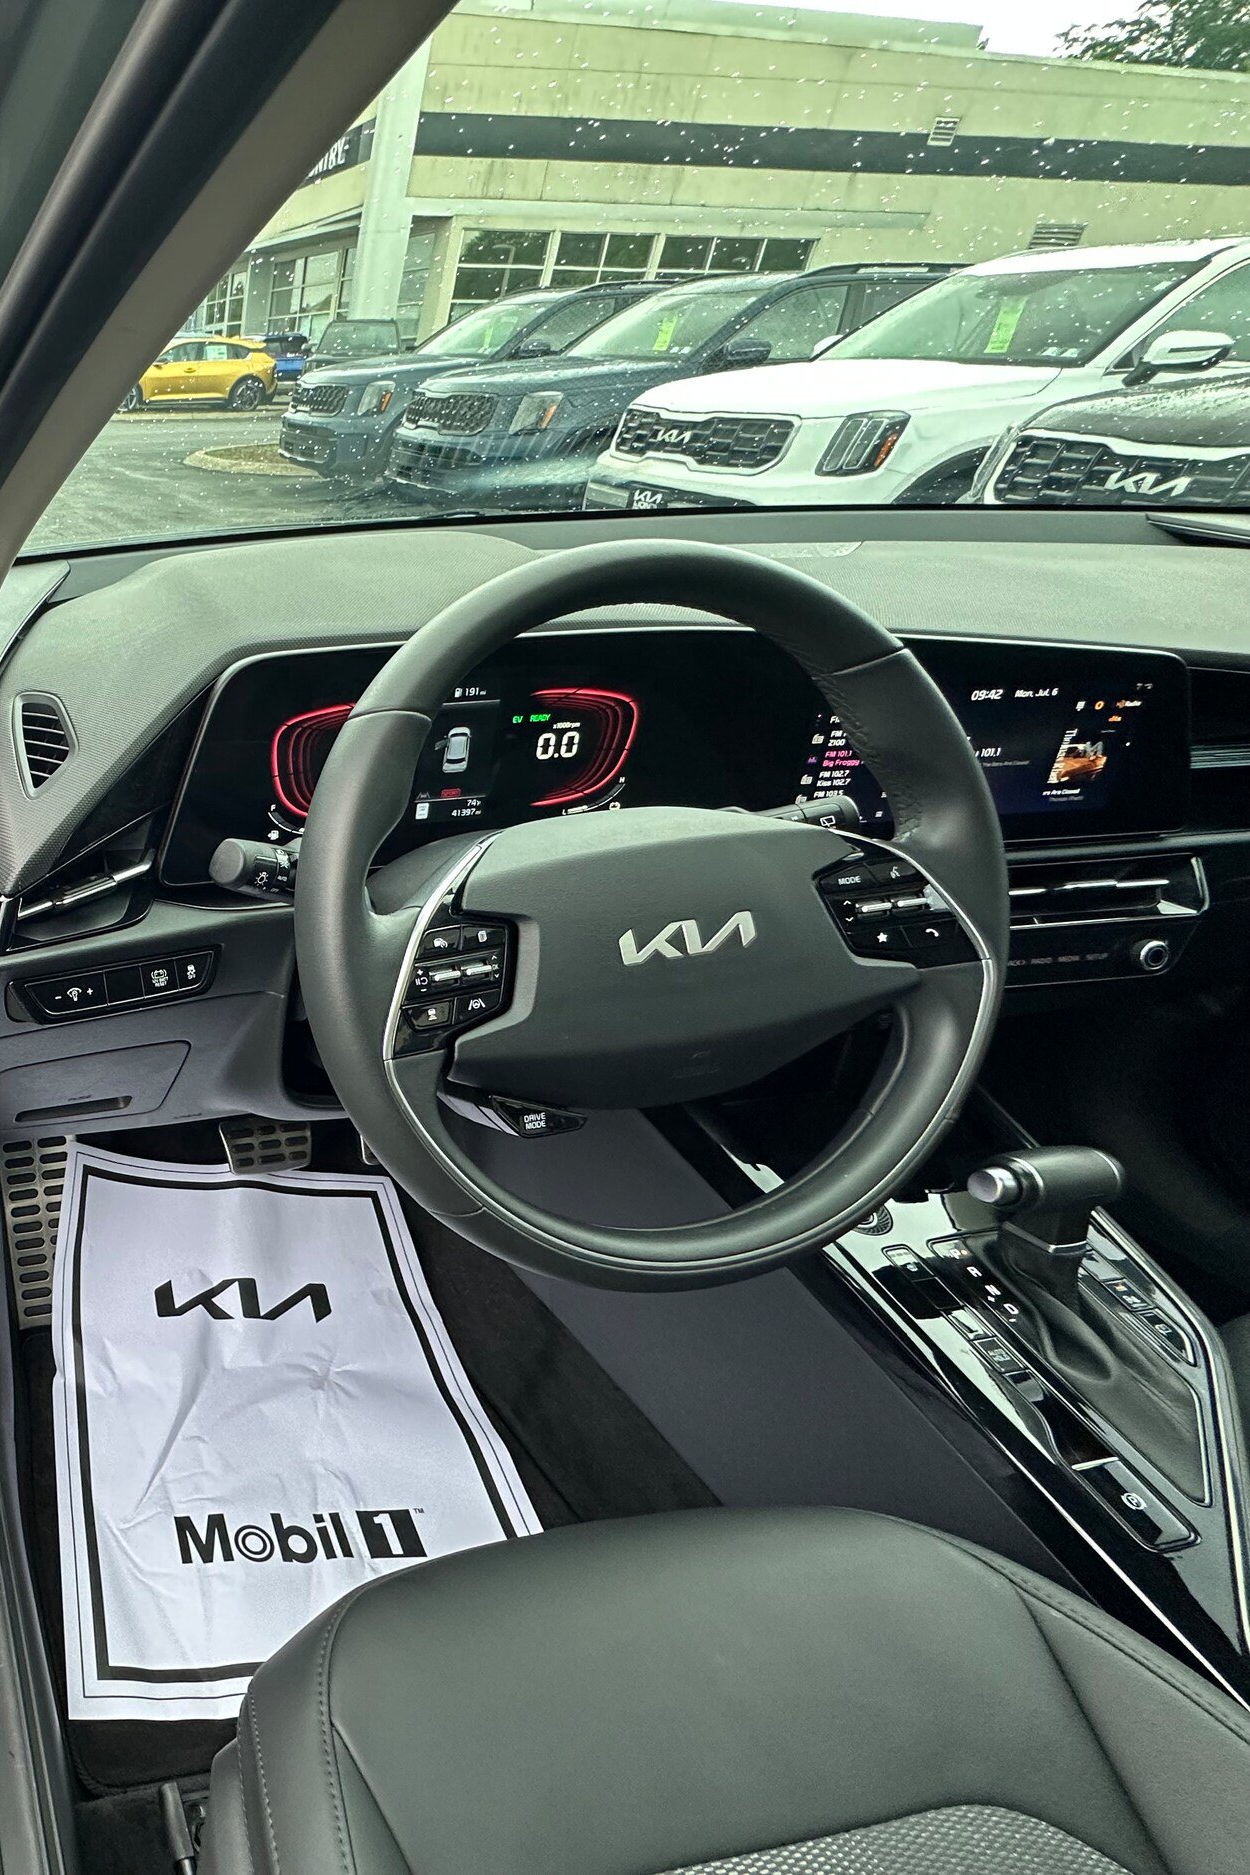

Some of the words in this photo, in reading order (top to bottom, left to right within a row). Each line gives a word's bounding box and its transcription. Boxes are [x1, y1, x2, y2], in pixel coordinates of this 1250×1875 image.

[654, 428, 692, 445] KIA
[1104, 467, 1192, 497] KIA
[633, 489, 663, 504] KIA
[971, 689, 1004, 701] 09:42
[1051, 687, 1059, 696] 6
[512, 716, 523, 724] EV
[530, 714, 551, 722] READY
[536, 731, 580, 760] 0.0
[981, 747, 1001, 757] 101.1
[822, 759, 834, 768] Big
[834, 758, 860, 767] Froggy
[819, 771, 830, 779] FM
[832, 778, 851, 786] 102.7
[813, 791, 826, 799] FM
[838, 875, 861, 885] MODE
[618, 910, 758, 967] KIA
[523, 1112, 546, 1123] DRIVE
[525, 1120, 546, 1130] MODE
[966, 1266, 983, 1278] R
[984, 1284, 1002, 1296] N
[154, 1277, 332, 1324] KIA
[1003, 1303, 1019, 1315] D
[173, 1512, 354, 1565] Mobil
